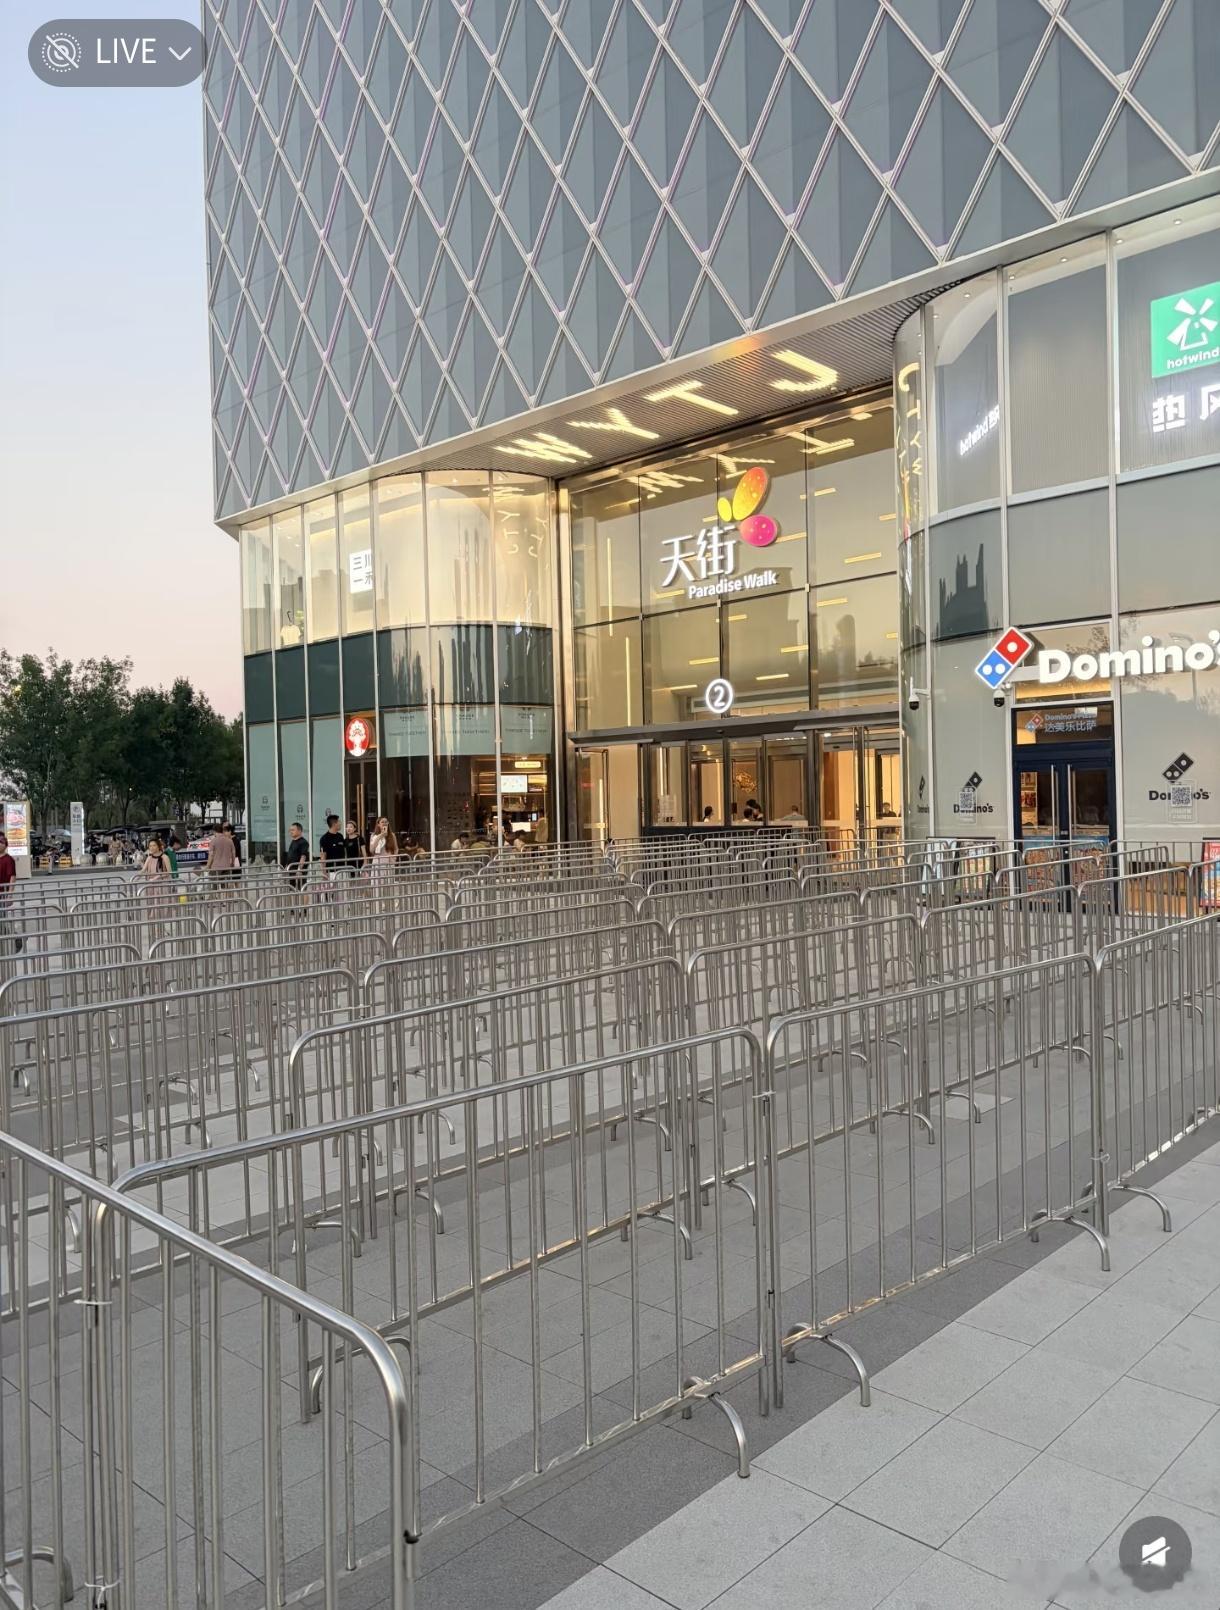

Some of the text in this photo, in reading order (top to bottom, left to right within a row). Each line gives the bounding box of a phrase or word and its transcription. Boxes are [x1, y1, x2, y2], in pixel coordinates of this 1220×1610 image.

[1167, 346, 1220, 369] hotwind
[660, 526, 737, 587] 天街
[688, 570, 777, 599] Paradise Walk
[1038, 629, 1220, 684] Domino'
[1044, 719, 1097, 733] 达美乐比萨
